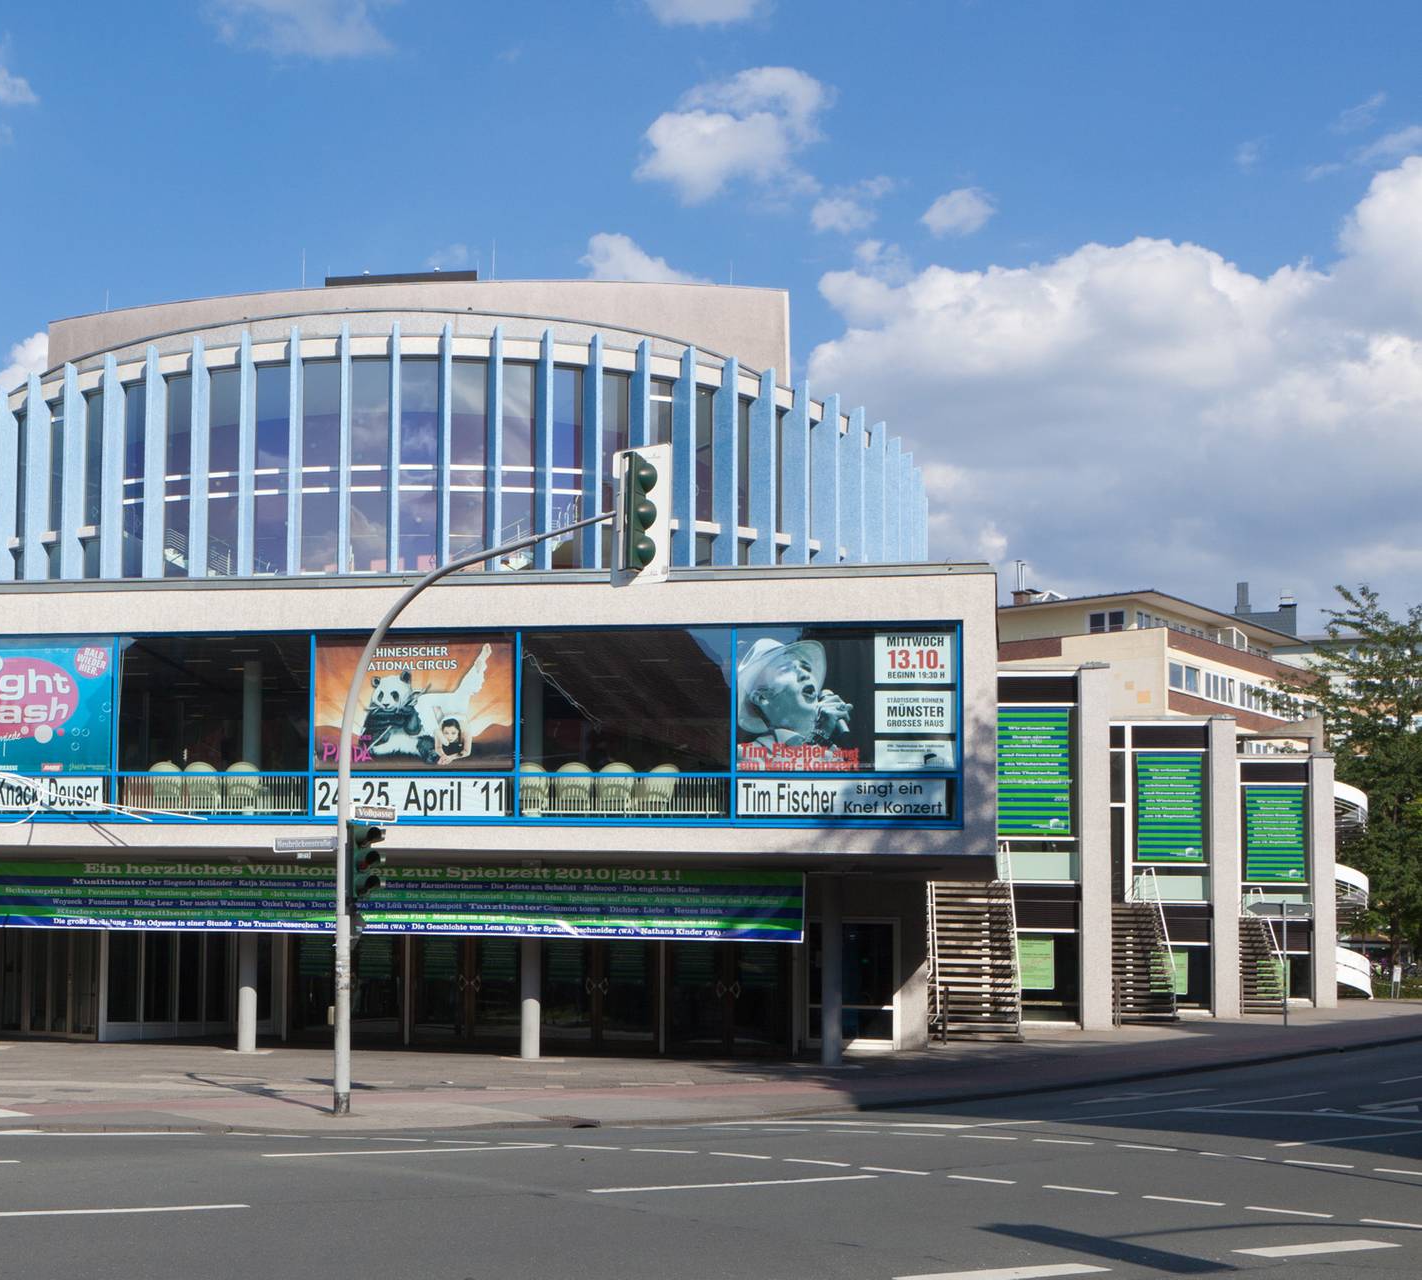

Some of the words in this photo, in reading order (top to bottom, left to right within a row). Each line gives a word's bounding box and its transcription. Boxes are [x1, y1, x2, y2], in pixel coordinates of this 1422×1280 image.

[886, 636, 944, 648] MITTWOCH
[373, 646, 448, 657] HINESISCHER
[368, 660, 458, 672] ATIONALCIRCUS
[888, 650, 944, 669] 13.10.
[887, 704, 944, 718] MÜNSTER
[924, 720, 944, 728] HAUS
[741, 743, 767, 758] Tim
[772, 742, 828, 758] Fischer
[48, 778, 99, 806] Deuser
[856, 782, 892, 798] singt
[898, 782, 922, 794] ein
[318, 781, 395, 811] 24-25.
[404, 781, 462, 816] April
[742, 784, 770, 812] Tim
[777, 784, 836, 812] Fischer
[844, 800, 880, 814] Knef
[884, 800, 942, 814] Konzert
[83, 864, 122, 874] Ein
[126, 864, 242, 875] herzliches
[247, 864, 397, 877] Willkomen
[402, 866, 442, 877] zur
[446, 867, 552, 881] Spielzeit
[68, 918, 87, 926] große
[147, 919, 176, 928] Odyssee
